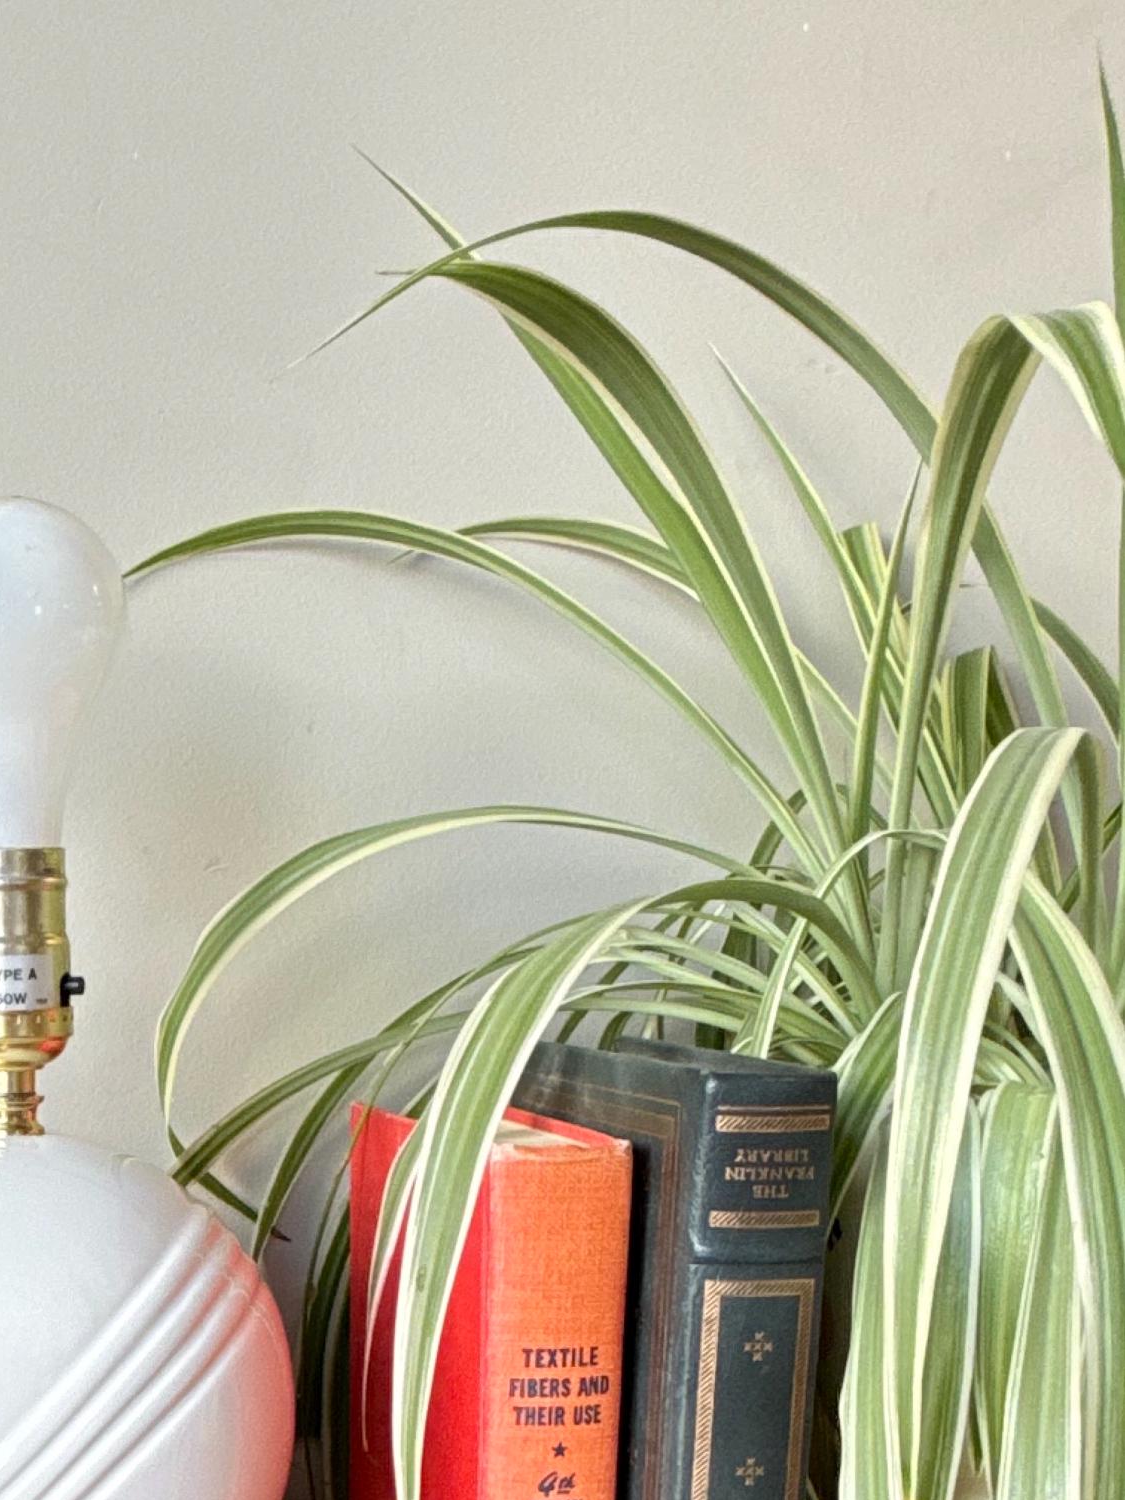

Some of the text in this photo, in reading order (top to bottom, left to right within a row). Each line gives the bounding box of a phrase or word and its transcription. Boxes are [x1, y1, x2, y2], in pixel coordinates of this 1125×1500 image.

[28, 968, 37, 980] A
[734, 1148, 810, 1163] LIBRARY
[724, 1166, 816, 1181] FRANKLIN
[751, 1184, 789, 1199] THE
[522, 1346, 599, 1368] TEXTILE
[509, 1375, 610, 1398] FIBERS AND
[513, 1404, 602, 1426] THEIR USE
